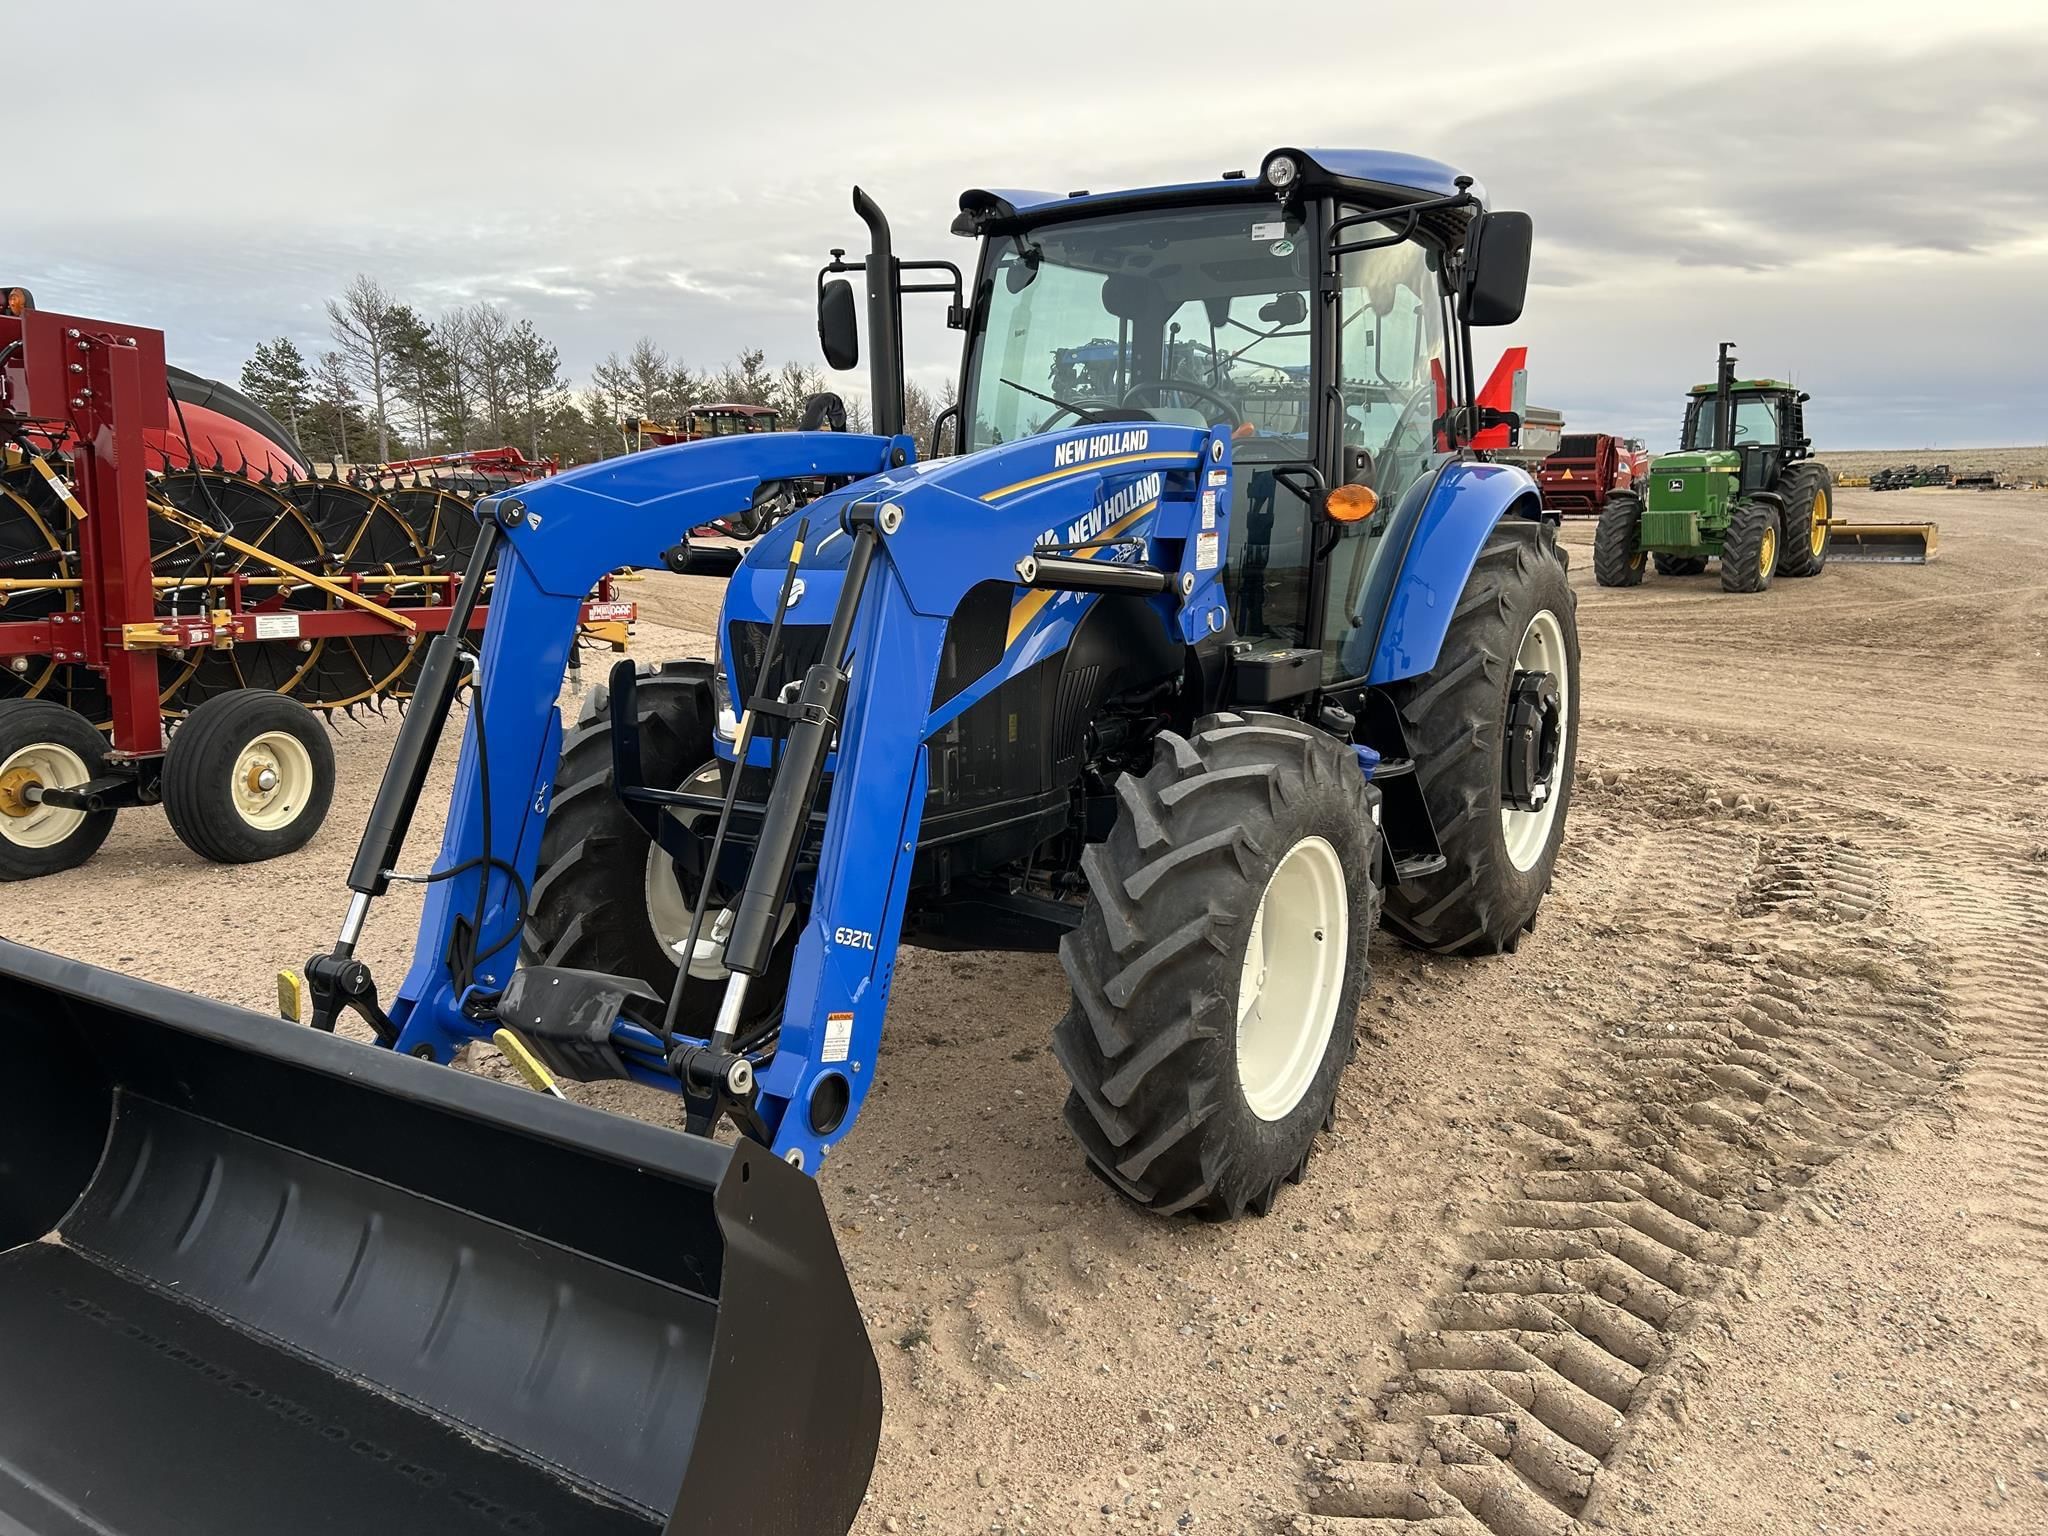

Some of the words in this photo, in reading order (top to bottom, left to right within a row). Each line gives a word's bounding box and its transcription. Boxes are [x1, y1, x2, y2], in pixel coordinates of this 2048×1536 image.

[1054, 438, 1088, 468] NEW
[1089, 429, 1148, 459] HOLLAND
[1067, 504, 1102, 548] NEW
[1104, 472, 1161, 527] HOLLAND
[834, 926, 874, 950] 632TL
